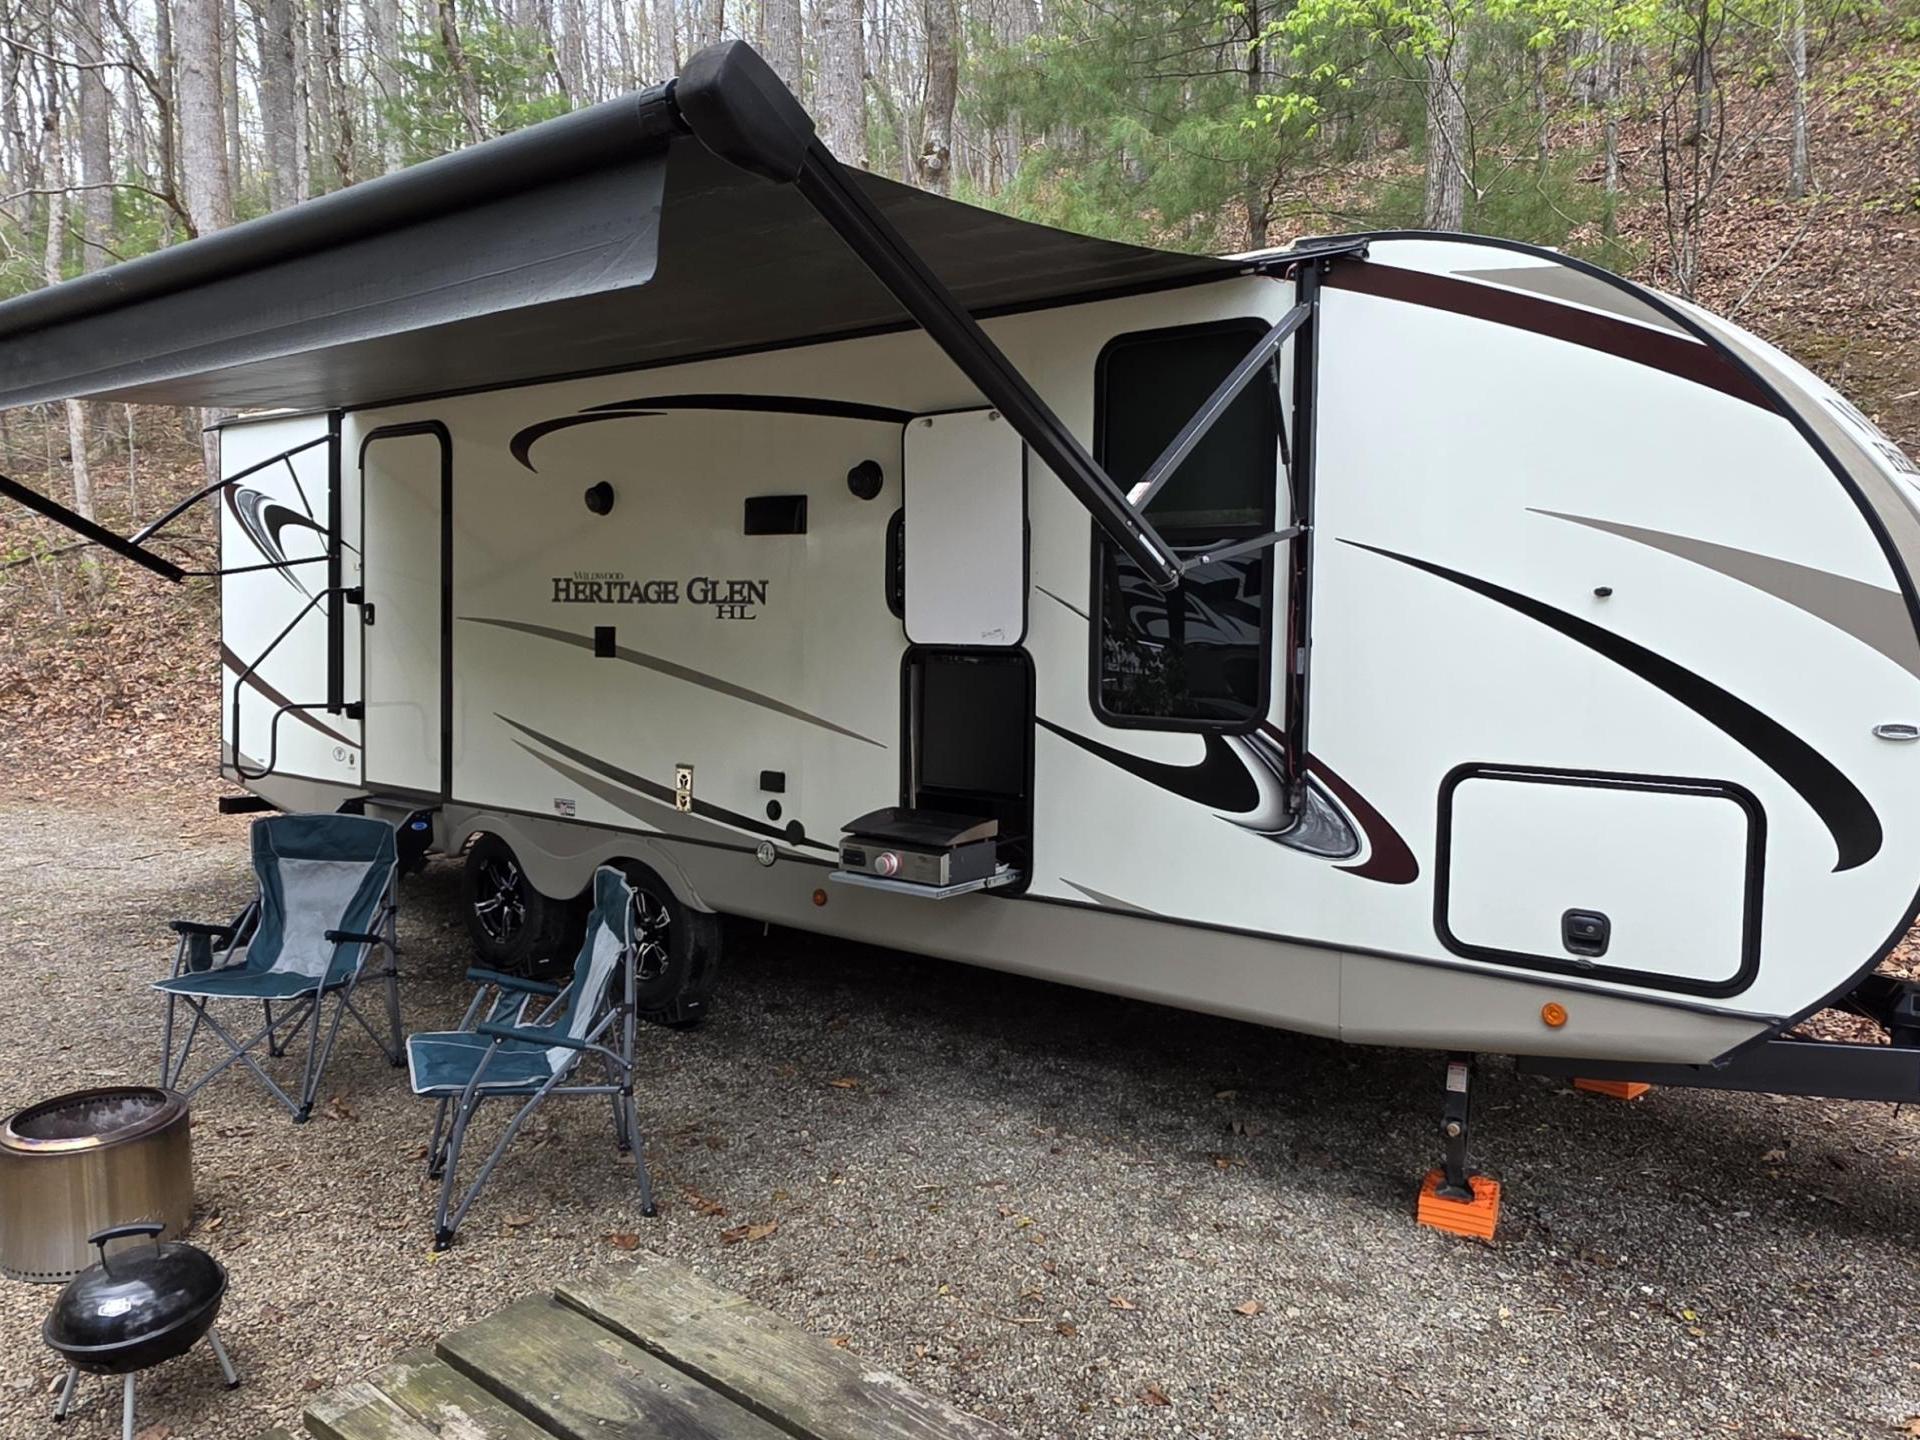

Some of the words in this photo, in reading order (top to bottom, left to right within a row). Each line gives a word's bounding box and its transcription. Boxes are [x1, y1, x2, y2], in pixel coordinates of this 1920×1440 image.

[552, 578, 679, 604] HERITAGE
[687, 577, 769, 605] GLEN
[716, 605, 757, 619] HL
